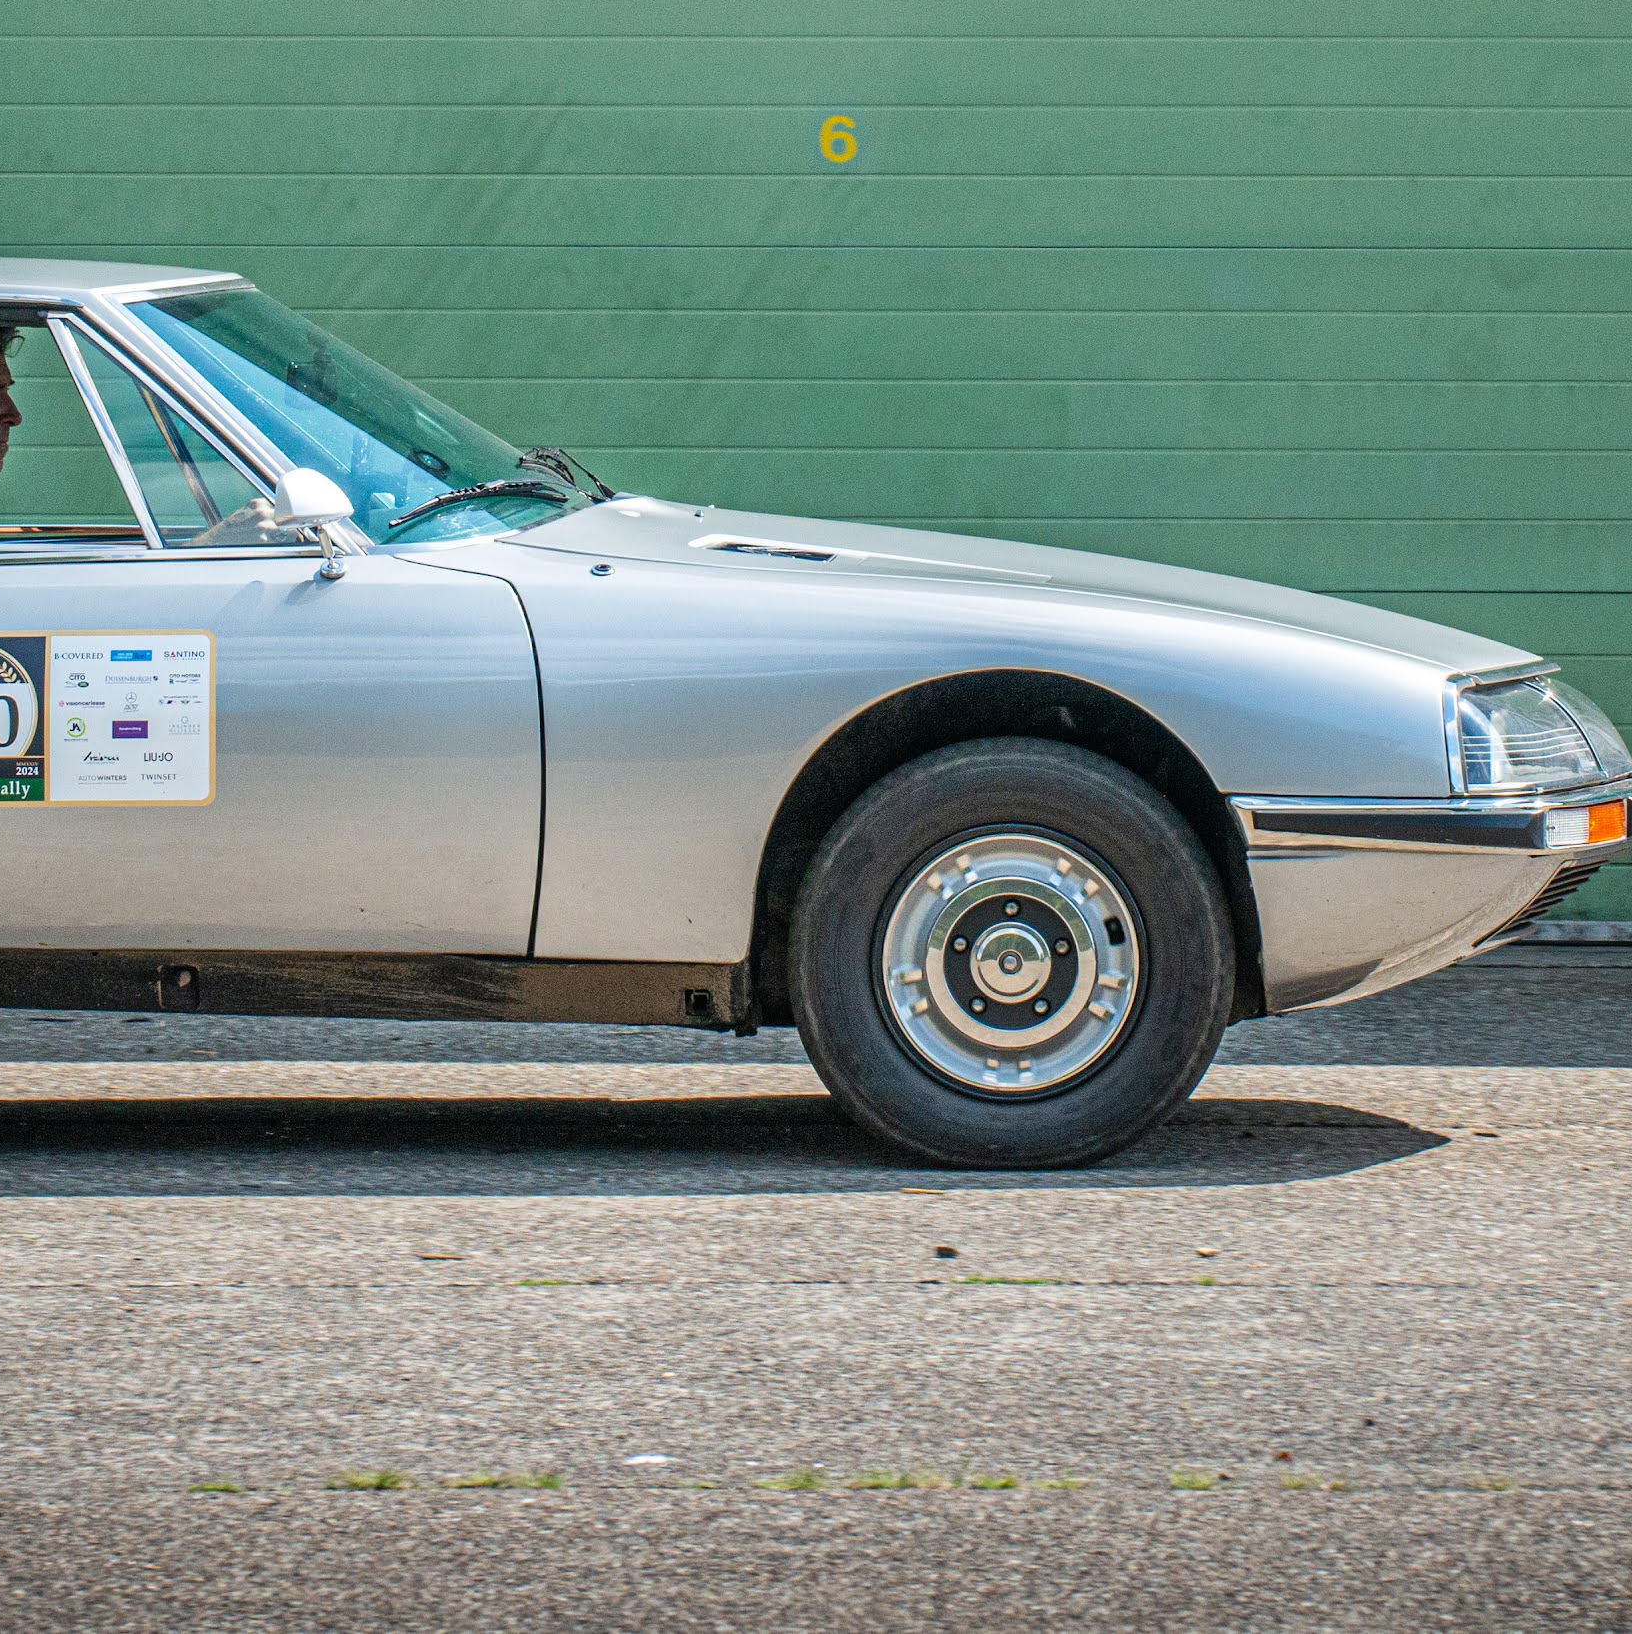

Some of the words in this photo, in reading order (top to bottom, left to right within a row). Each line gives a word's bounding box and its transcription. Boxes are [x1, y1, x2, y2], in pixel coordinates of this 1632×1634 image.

[819, 115, 858, 164] 6
[15, 766, 39, 776] 2024
[141, 773, 177, 781] TWINSET
